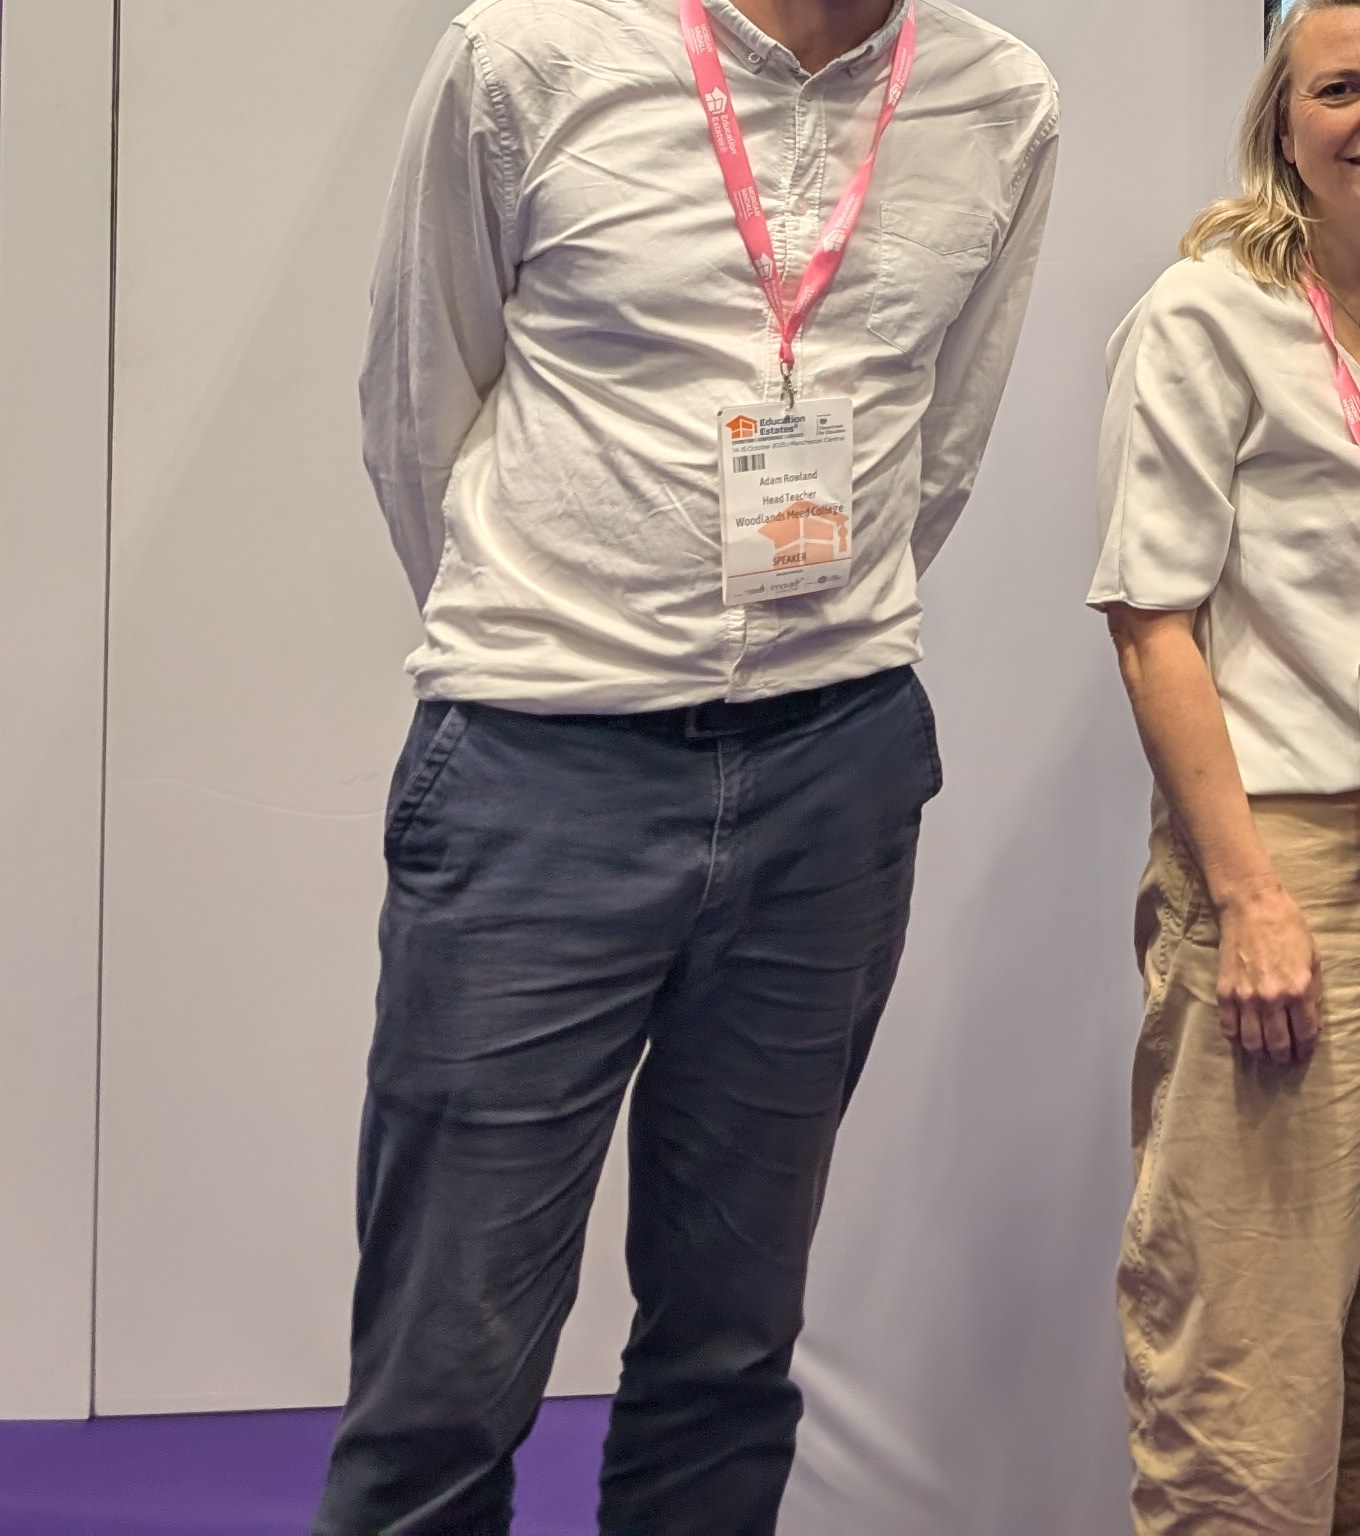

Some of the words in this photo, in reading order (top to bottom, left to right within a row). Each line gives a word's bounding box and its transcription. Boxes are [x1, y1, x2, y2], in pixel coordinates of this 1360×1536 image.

[760, 476, 782, 486] Adam
[784, 470, 818, 483] Rowland
[763, 494, 785, 505] Head
[786, 491, 816, 502] Teacher
[736, 512, 785, 527] Woodlands
[773, 553, 807, 566] SPEAKER
